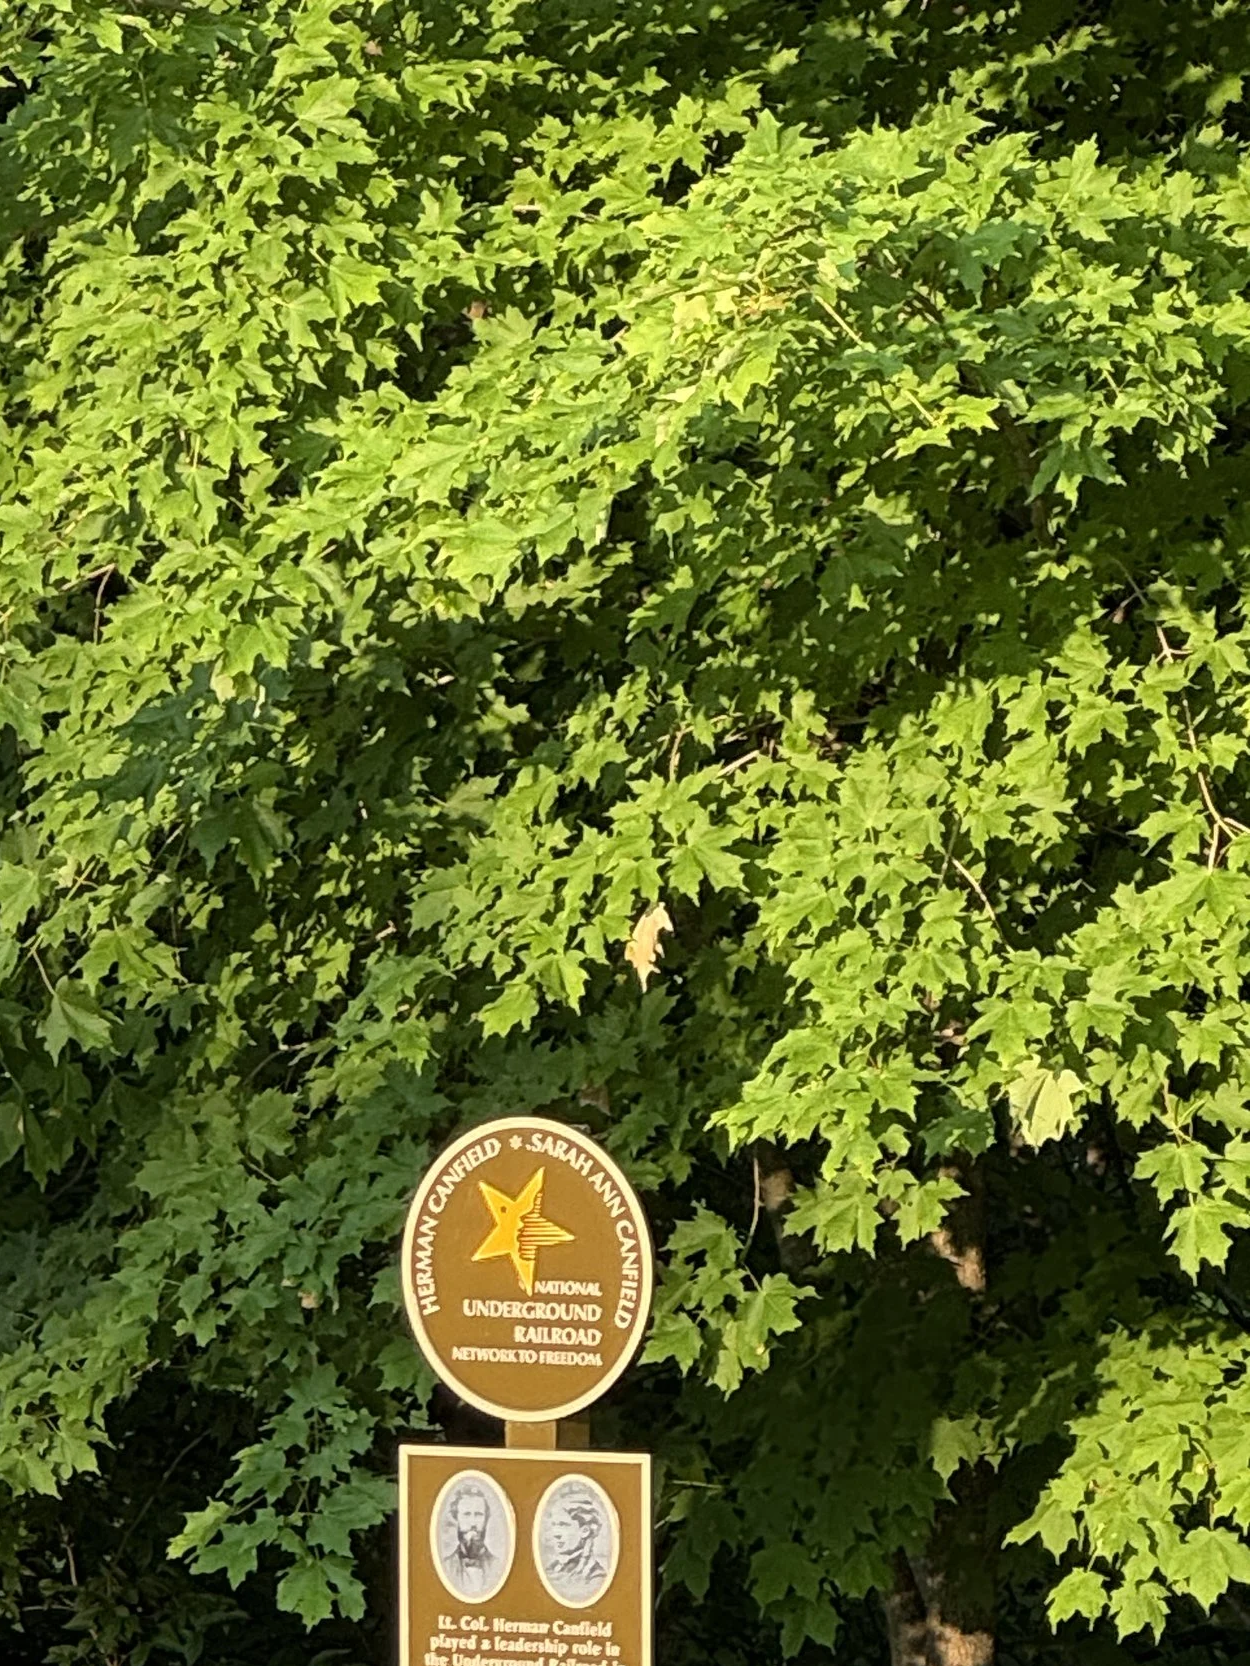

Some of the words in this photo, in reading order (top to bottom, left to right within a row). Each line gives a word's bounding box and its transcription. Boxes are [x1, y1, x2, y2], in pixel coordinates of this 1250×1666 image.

[415, 1216, 440, 1316] HERMAN
[428, 1137, 502, 1214] CANFIELD
[530, 1133, 596, 1177] SARAH
[588, 1172, 625, 1217] ANN
[614, 1220, 639, 1329] CANFIELD
[534, 1280, 602, 1297] NATIONAL
[463, 1299, 602, 1322] UNDERGROUND
[514, 1325, 602, 1345] RAILROAD
[452, 1346, 518, 1363] NETWORK
[518, 1348, 537, 1363] TO
[539, 1349, 603, 1367] FREEDOM
[438, 1614, 457, 1630] Lt.
[460, 1616, 489, 1632] Col.
[493, 1617, 550, 1635] Herman
[552, 1620, 612, 1638] Canfield
[430, 1634, 477, 1652] played
[481, 1639, 492, 1650] a
[494, 1636, 568, 1657] leadership
[572, 1640, 602, 1656] role
[605, 1642, 620, 1657] in
[425, 1652, 449, 1666] the
